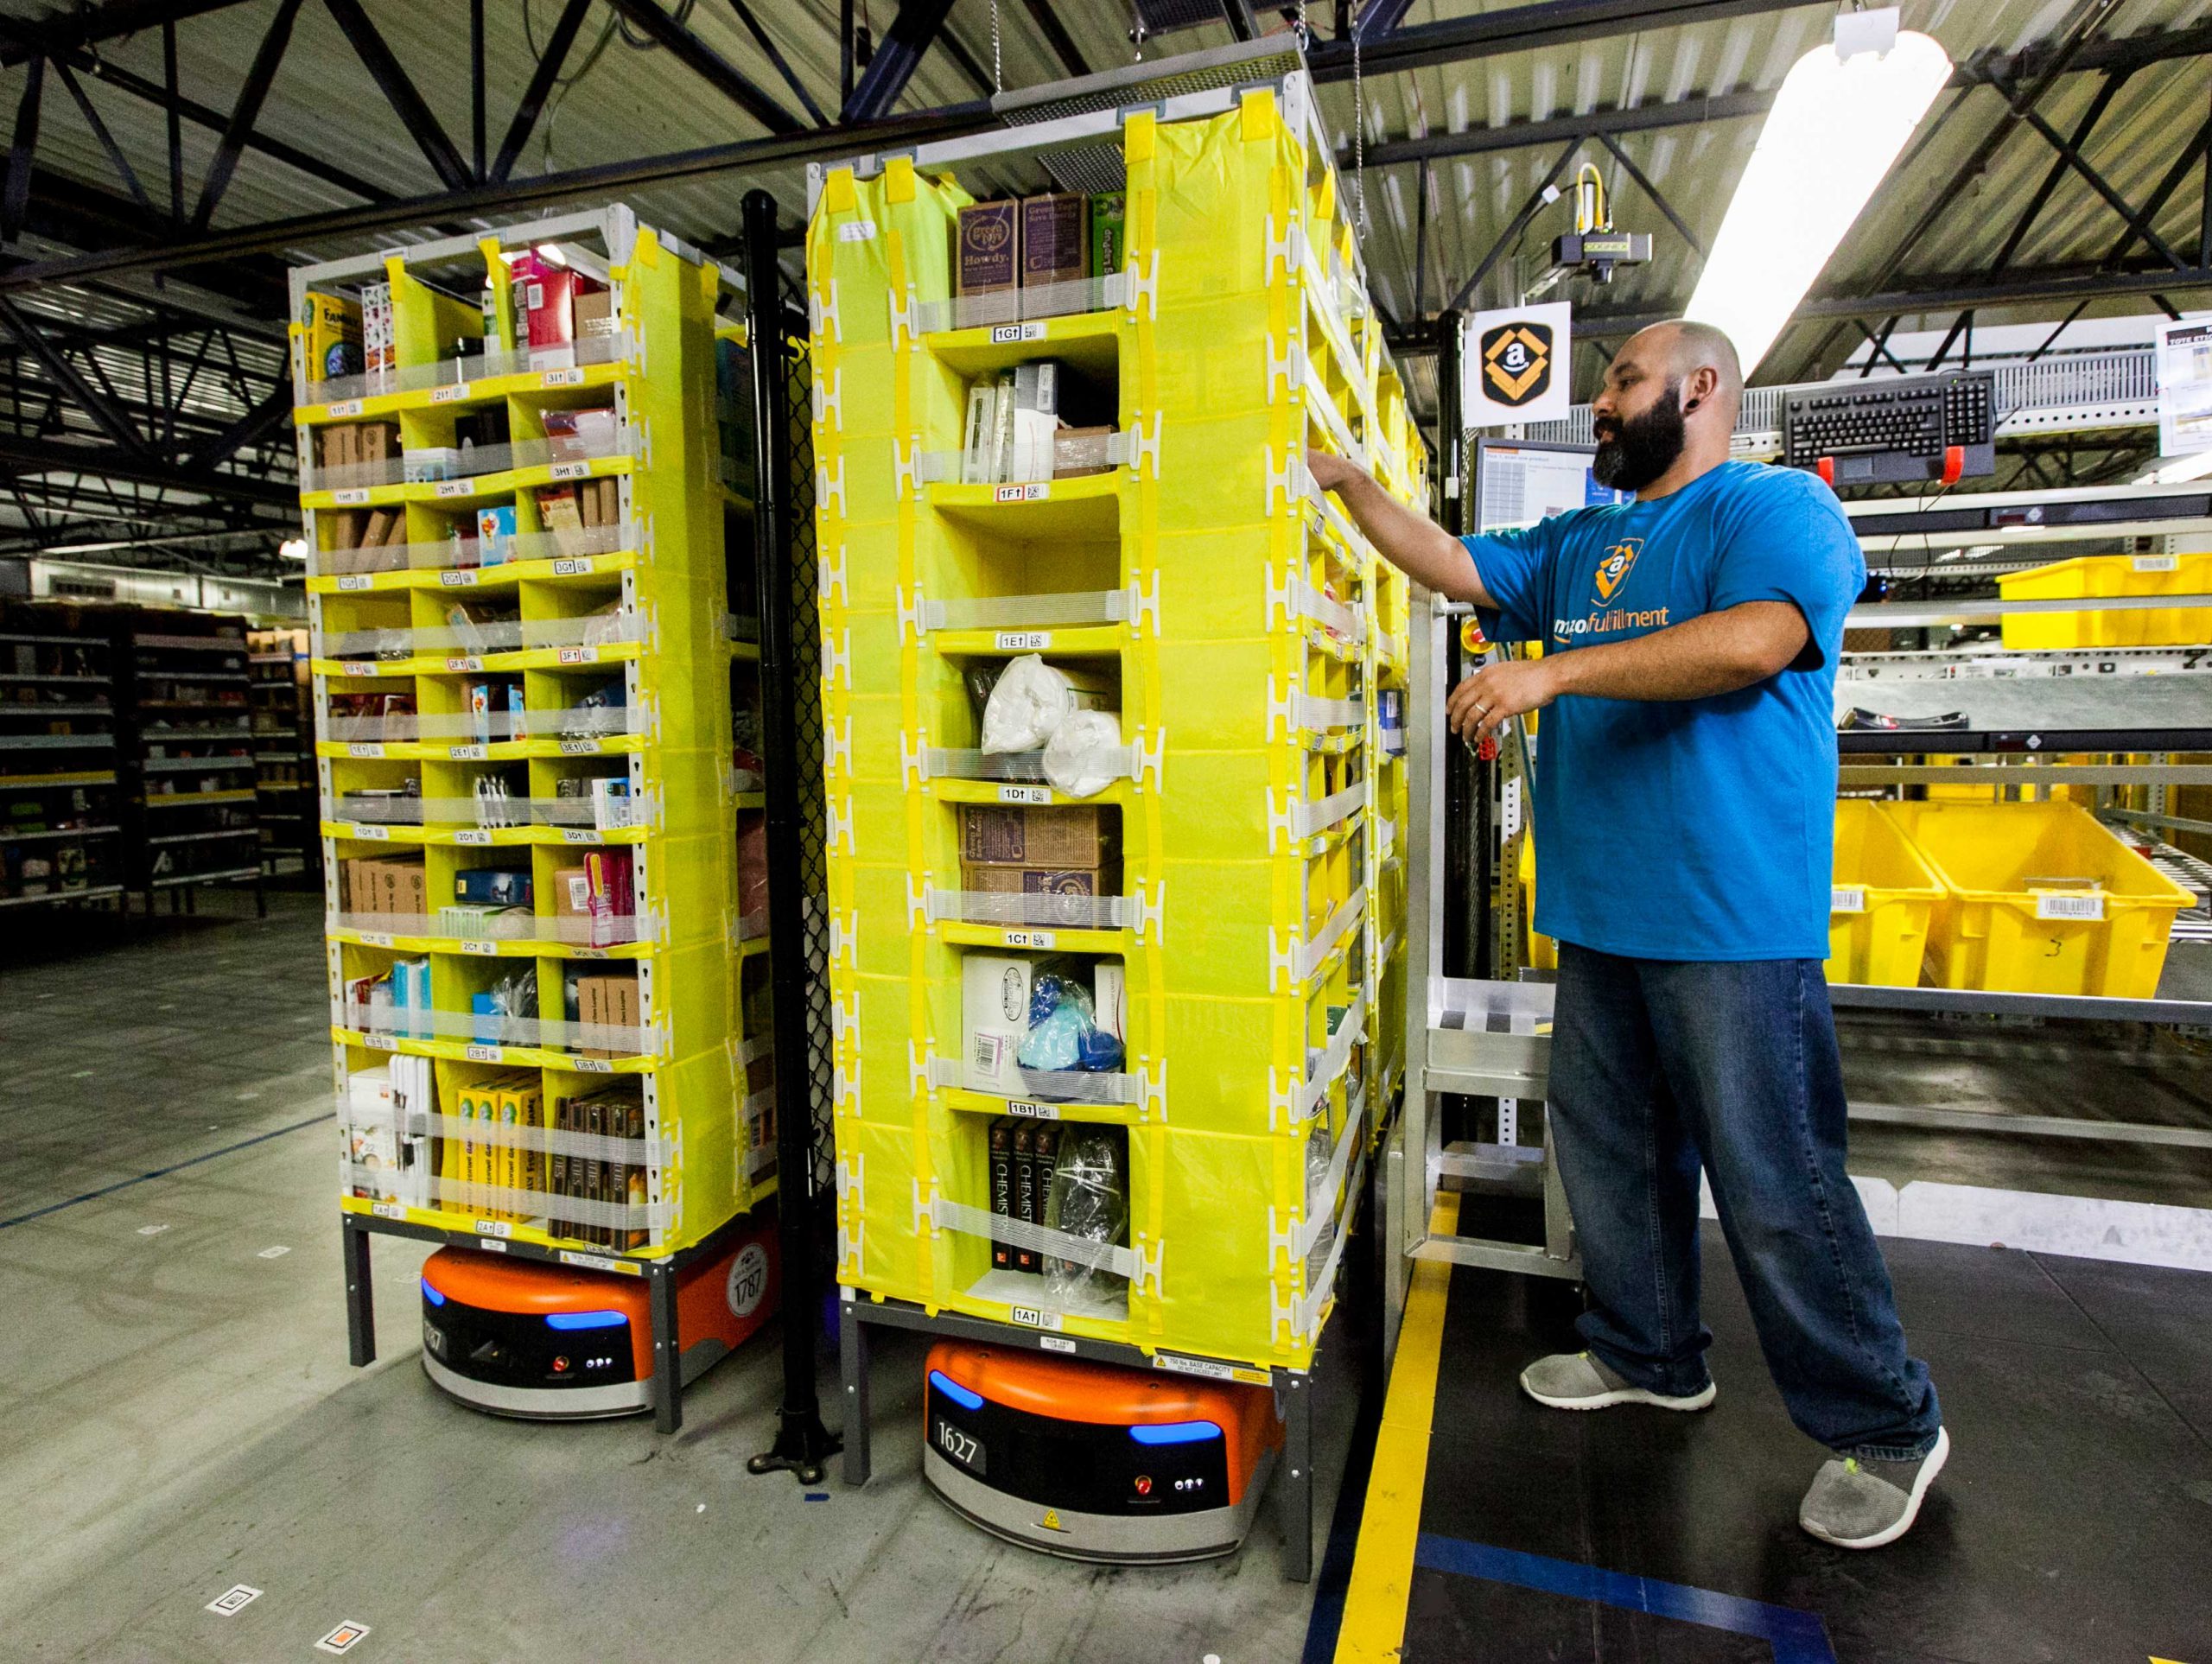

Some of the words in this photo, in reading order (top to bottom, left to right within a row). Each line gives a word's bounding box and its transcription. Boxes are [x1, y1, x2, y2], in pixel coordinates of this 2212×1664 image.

[996, 328, 1013, 340] 1G
[554, 467, 567, 477] 3H
[1000, 490, 1014, 499] 1F
[556, 562, 569, 572] 3G
[443, 574, 455, 584] 2G
[1003, 637, 1017, 646] 1E
[562, 651, 573, 661] 3F
[450, 660, 461, 670] 2F
[452, 748, 463, 757] 2E
[563, 743, 575, 752] 3E
[1005, 789, 1020, 799] 1D
[458, 833, 469, 842] 2D
[566, 831, 578, 841] 3D
[1007, 934, 1023, 944] 1C
[463, 942, 474, 951] 2C
[469, 1049, 481, 1058] 2B
[1012, 1103, 1027, 1114] 1B
[478, 1222, 489, 1232] 2A
[734, 1267, 762, 1307] 1787
[1016, 1310, 1030, 1321] 1A
[1189, 1360, 1203, 1369] BASE
[1204, 1362, 1230, 1374] CAPACITY
[939, 1421, 977, 1464] 1627
